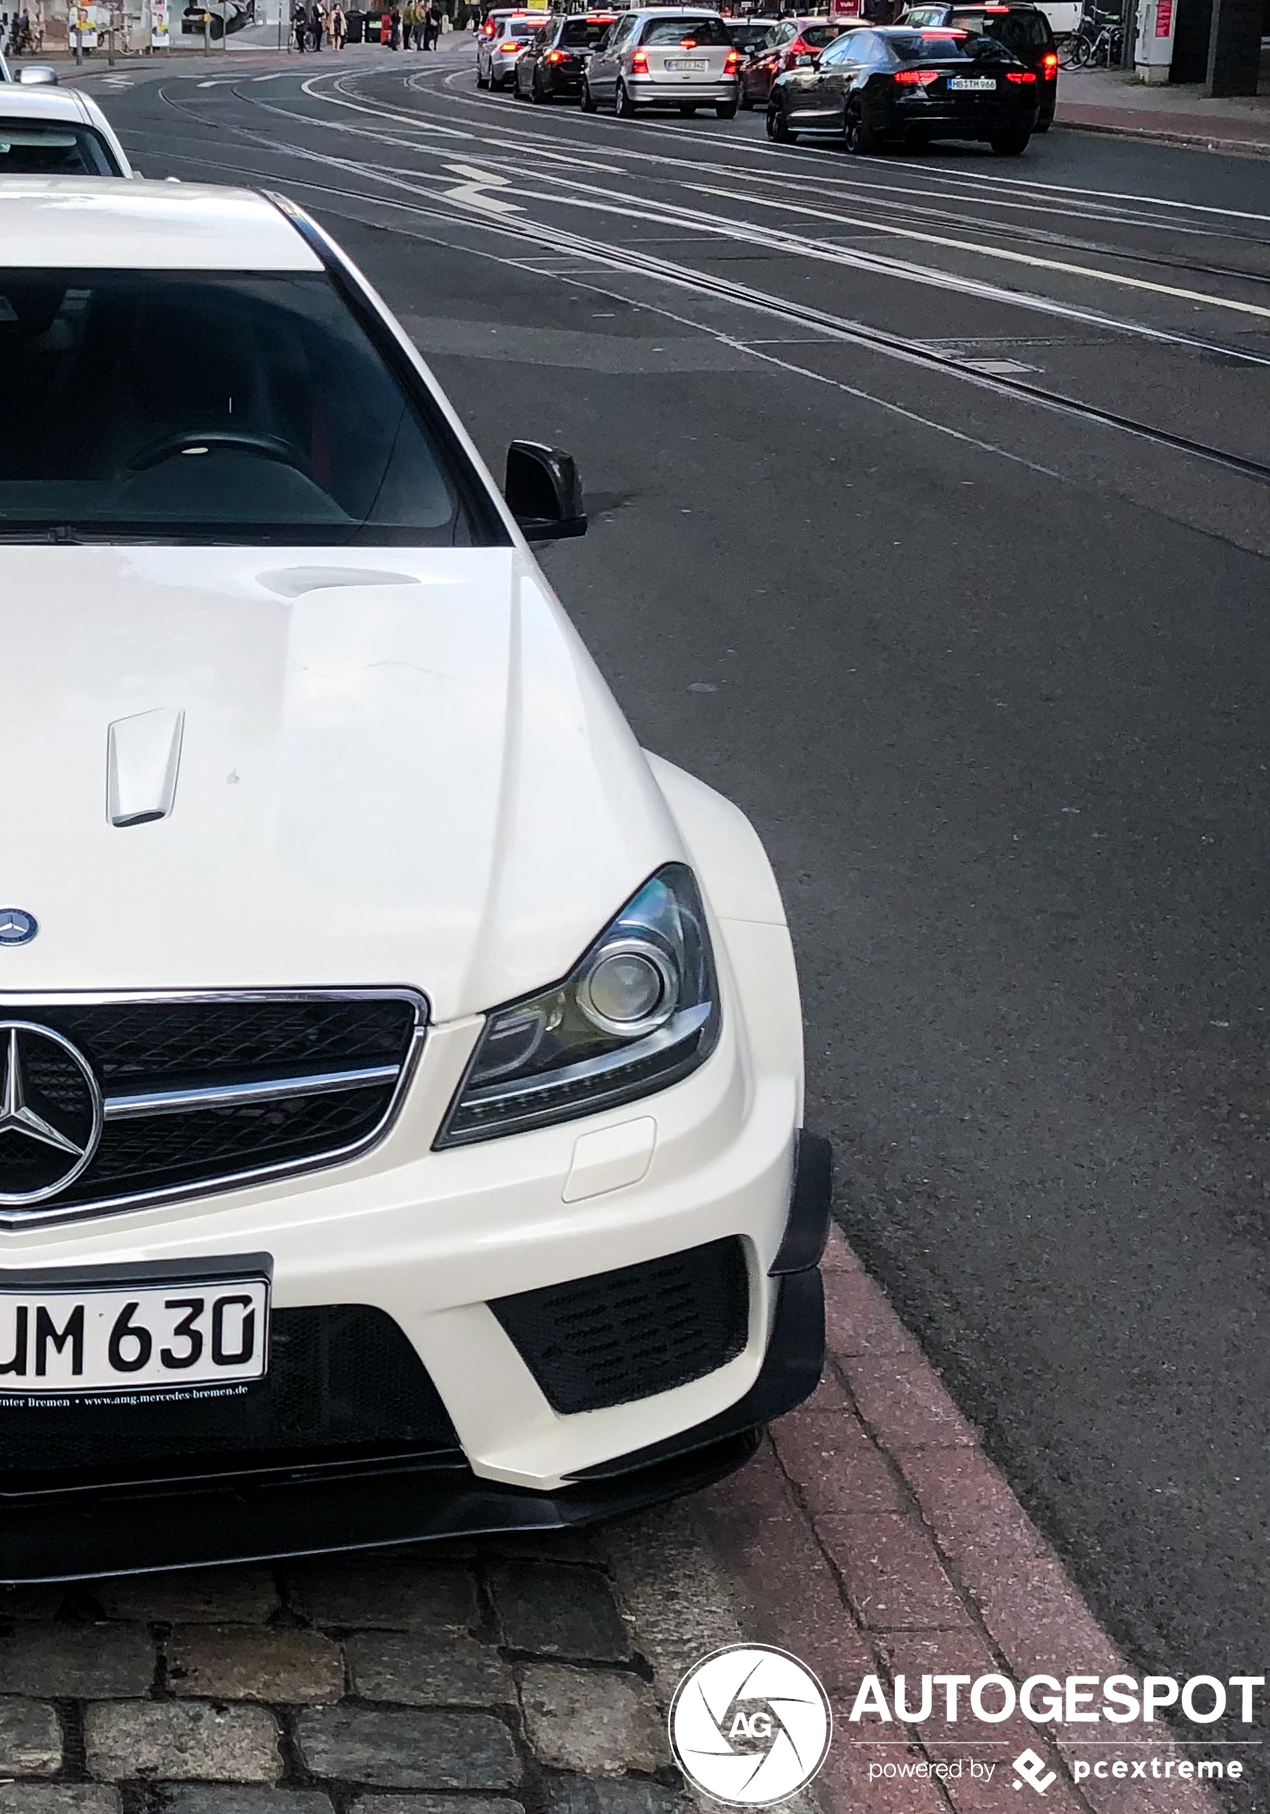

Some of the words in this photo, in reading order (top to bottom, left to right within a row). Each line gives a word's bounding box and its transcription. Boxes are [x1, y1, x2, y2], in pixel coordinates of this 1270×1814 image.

[107, 1295, 255, 1374] 630
[28, 1397, 70, 1407] Bremen
[84, 1385, 248, 1406] www.amg.mercedes-bremen.de
